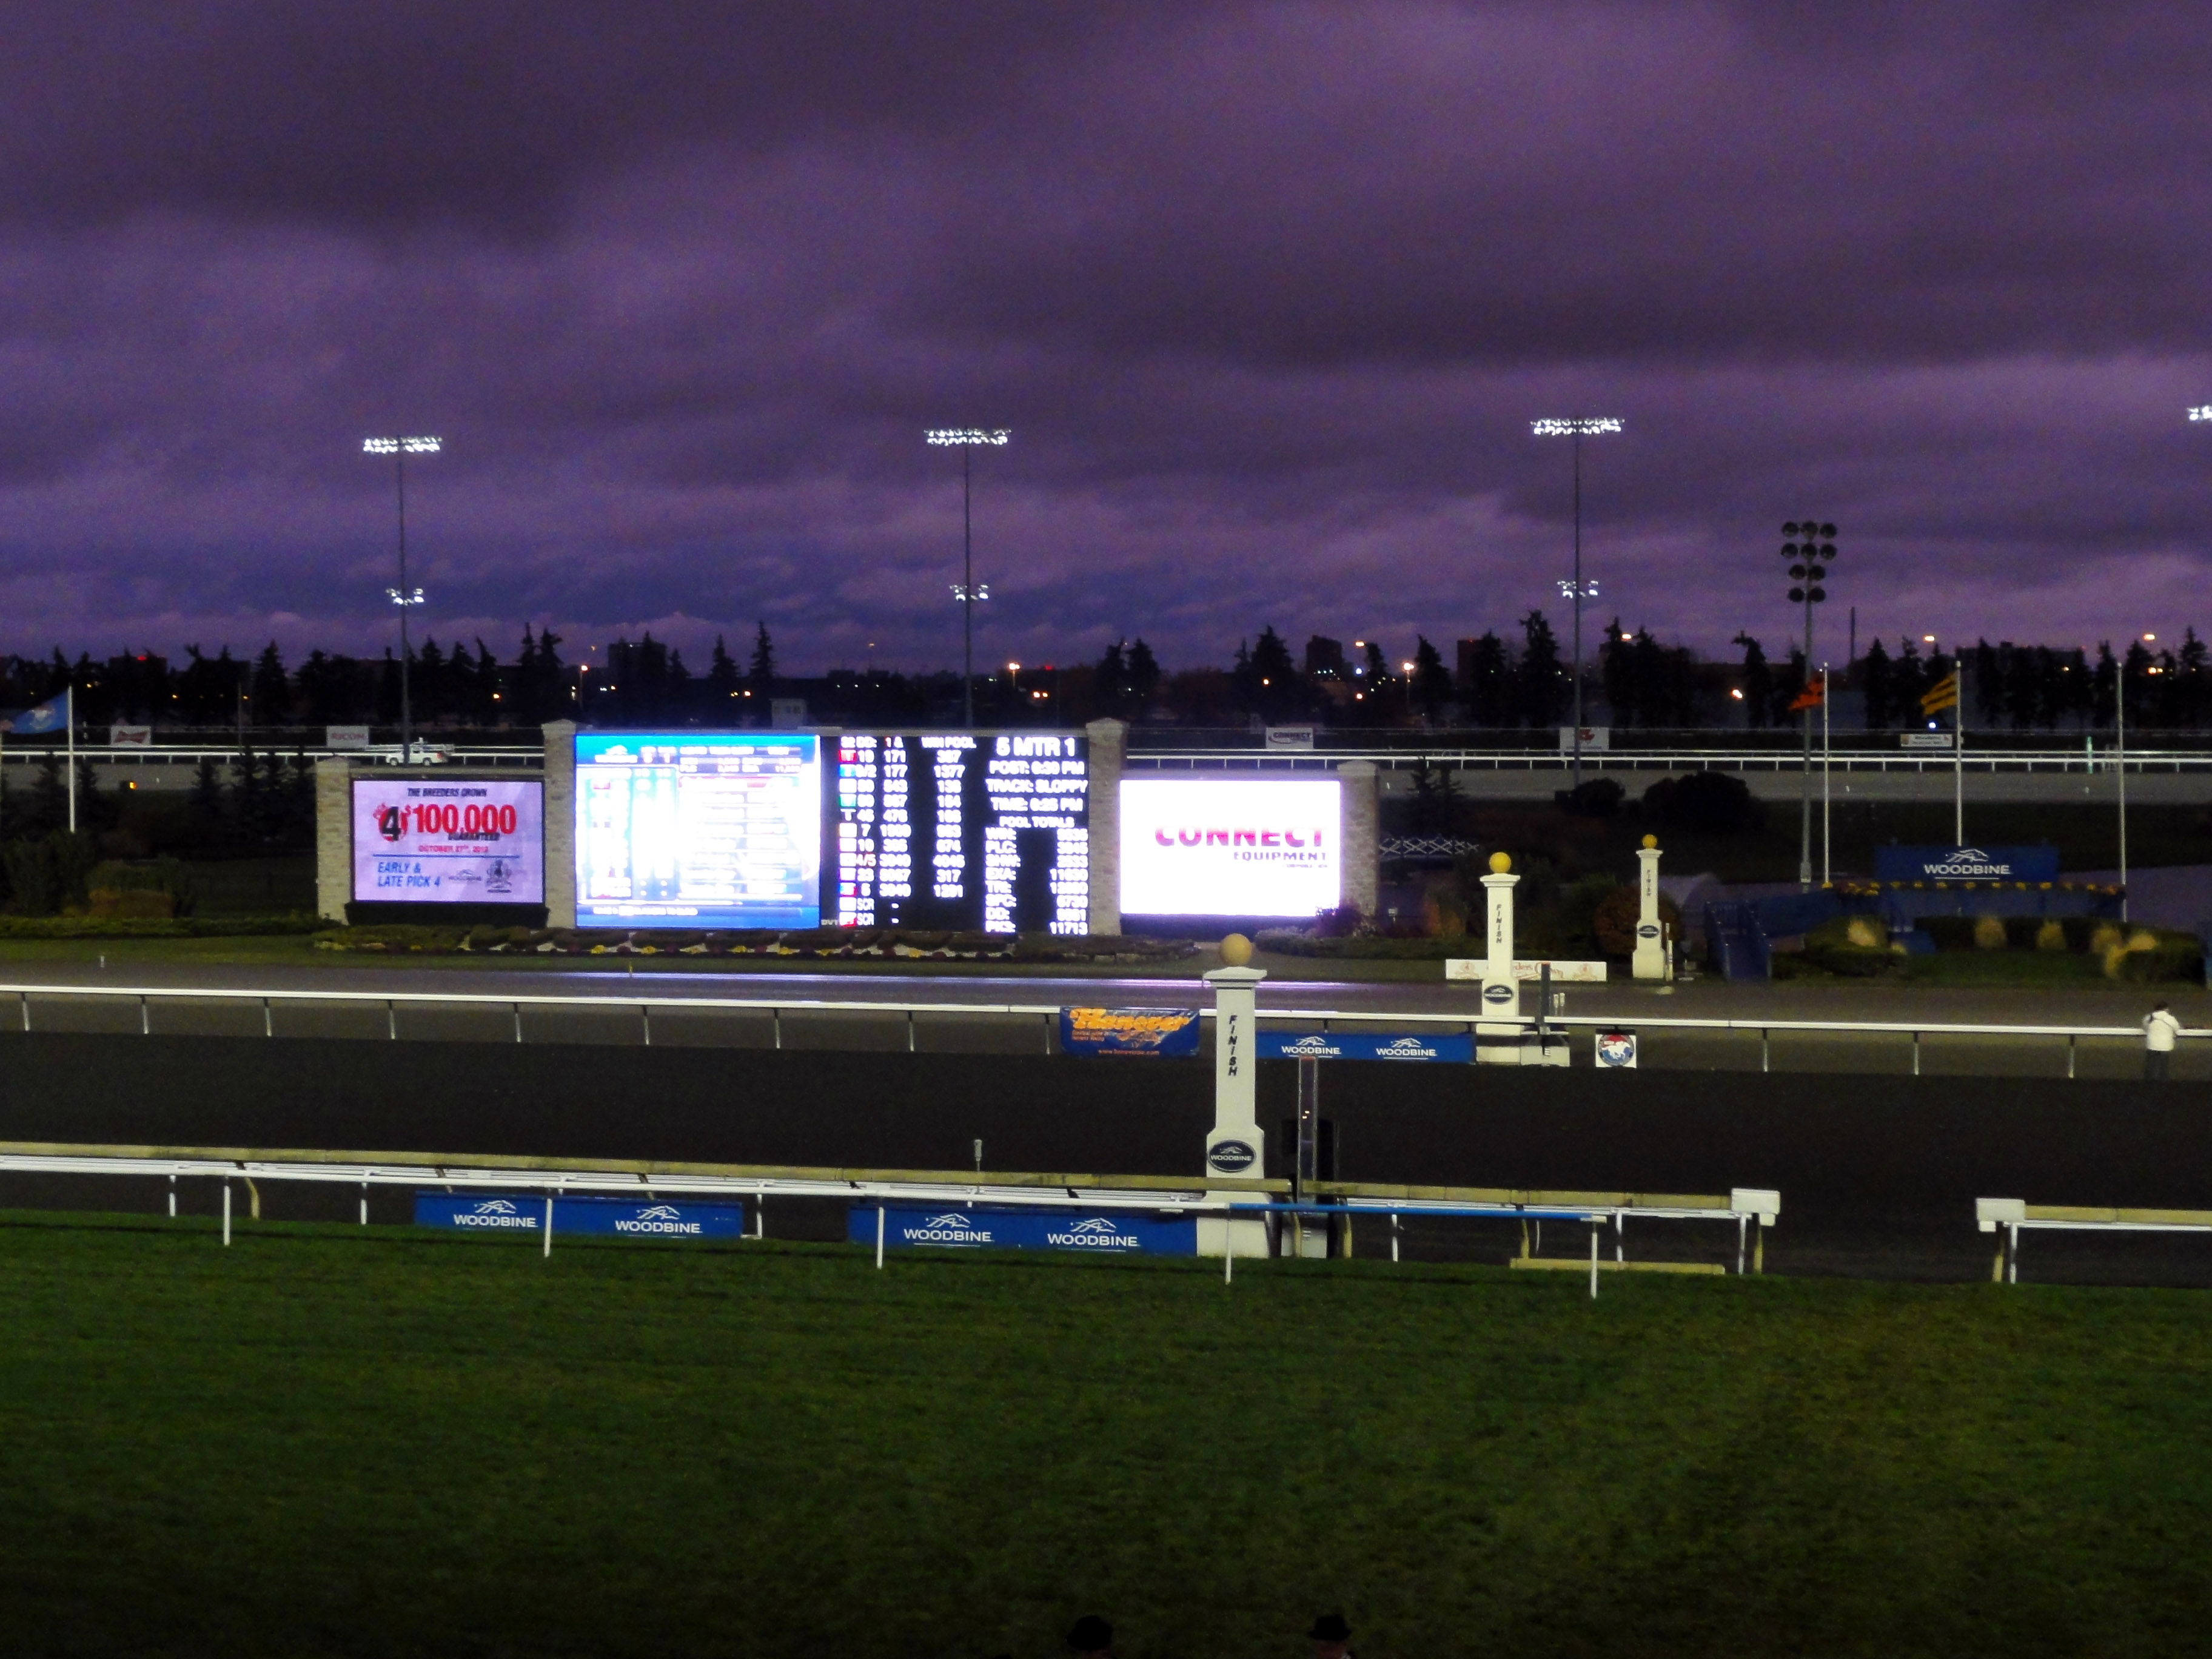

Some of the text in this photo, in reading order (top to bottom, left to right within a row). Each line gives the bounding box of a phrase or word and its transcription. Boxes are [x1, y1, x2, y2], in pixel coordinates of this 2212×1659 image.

[945, 737, 976, 748] POOL
[996, 737, 1074, 756] 5 MTR 1
[884, 765, 908, 777] 177
[990, 760, 1030, 774] POST:
[1061, 761, 1084, 774] PM
[407, 788, 488, 797] THE BREEDERS CROWN
[986, 779, 1088, 793] TRACK: SLOPPY
[991, 797, 1028, 811] TIME:
[1060, 798, 1083, 811] PM
[381, 806, 401, 841] 4
[999, 816, 1074, 828] POOL TOTALS
[861, 823, 871, 837] 7
[1155, 826, 1326, 848] CONNECT
[856, 854, 876, 866] 4/5
[1233, 851, 1327, 861] EQUIPMENT
[377, 862, 421, 873] EARLY &
[1923, 864, 2011, 874] WOODBINE
[377, 876, 441, 888] LATE PICK 4
[857, 898, 874, 911] SCR
[857, 913, 874, 925] SCR
[1050, 922, 1088, 935] 11713
[1228, 1014, 1238, 1076] FINISH
[1281, 1045, 1341, 1055] WOODBINE
[1376, 1048, 1436, 1057] WOODBINE
[454, 1214, 537, 1228] WOODBINE
[615, 1220, 702, 1234] WOODBINE
[904, 1228, 993, 1242] WOODBINE
[1047, 1233, 1139, 1247] WOODBINE
